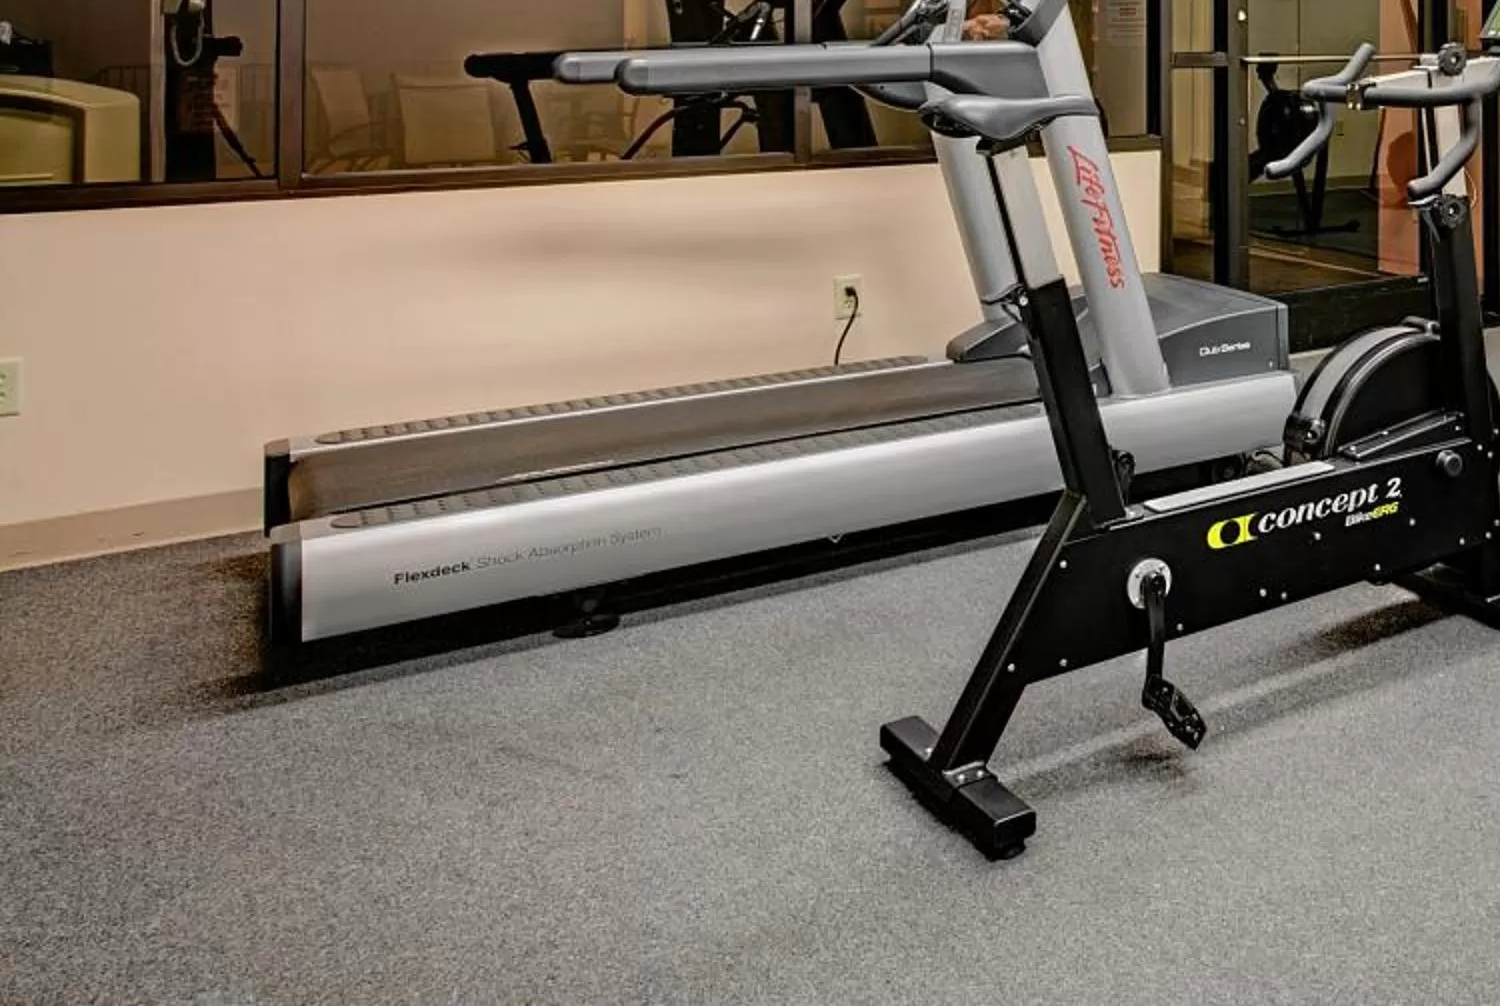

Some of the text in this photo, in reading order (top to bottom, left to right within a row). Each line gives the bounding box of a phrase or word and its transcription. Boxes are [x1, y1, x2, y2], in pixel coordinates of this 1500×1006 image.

[1257, 476, 1403, 534] concept 2
[393, 560, 471, 586] Flexdeck
[476, 550, 529, 571] Shock
